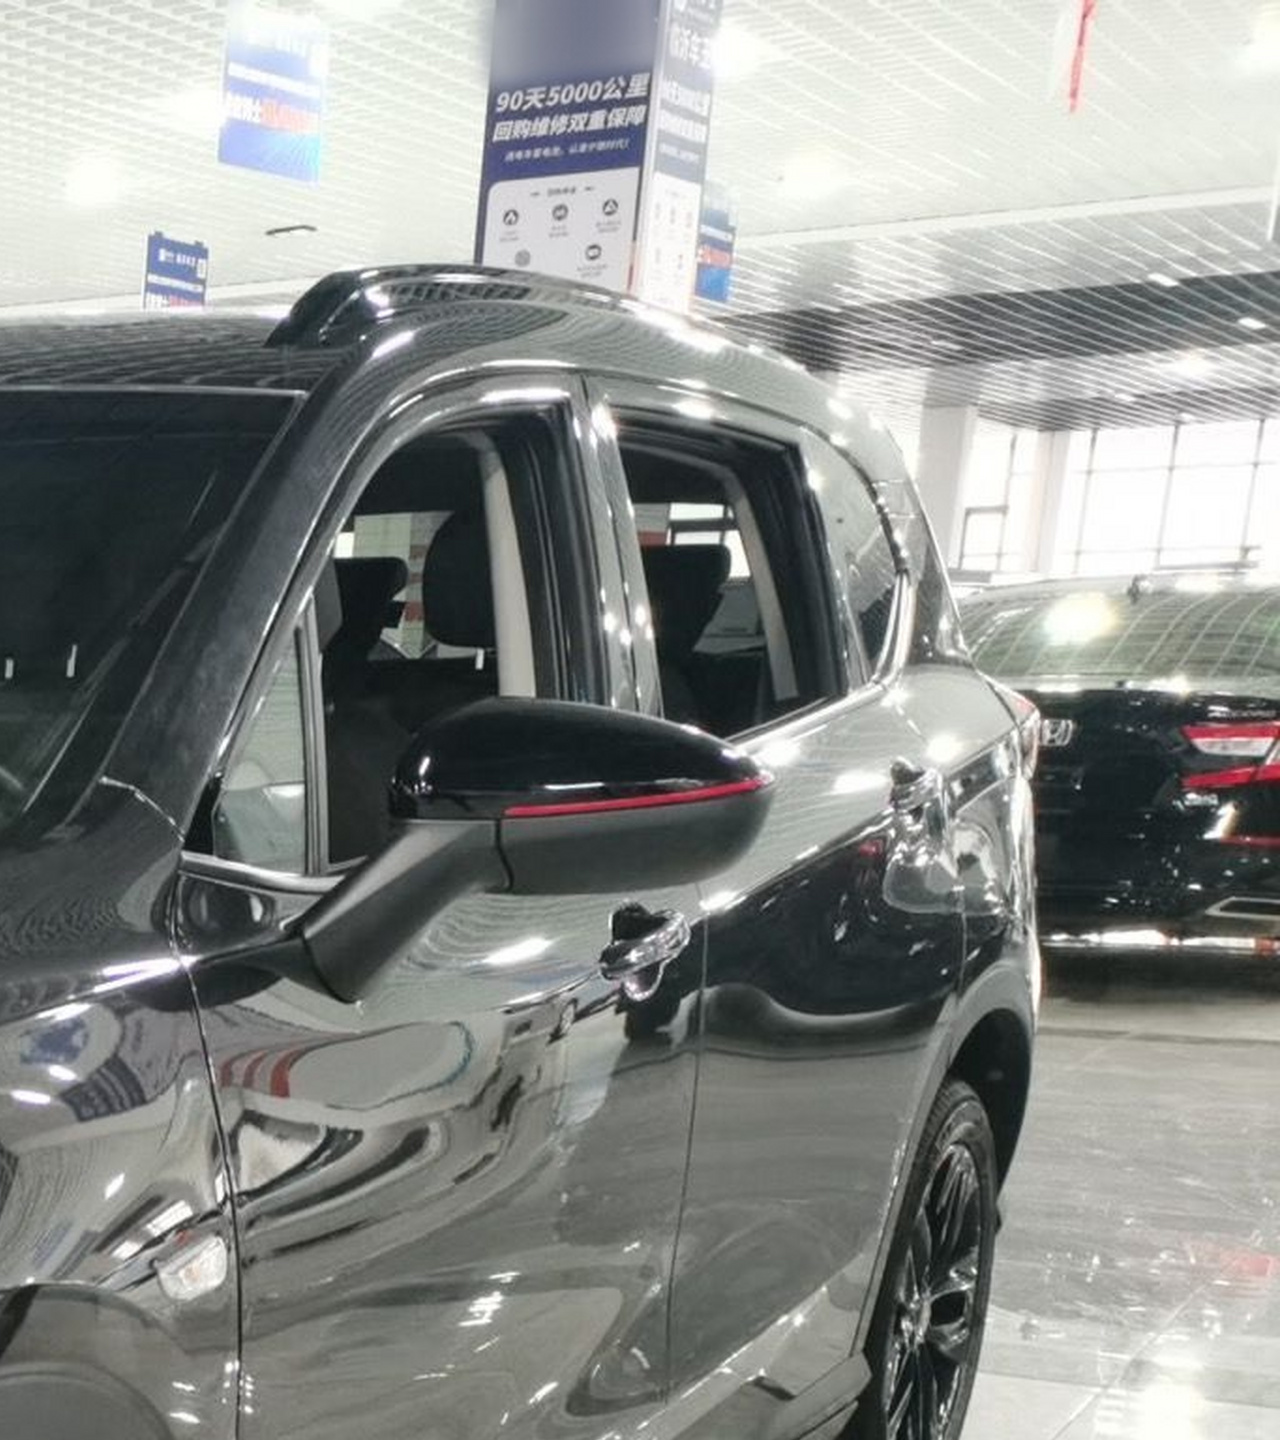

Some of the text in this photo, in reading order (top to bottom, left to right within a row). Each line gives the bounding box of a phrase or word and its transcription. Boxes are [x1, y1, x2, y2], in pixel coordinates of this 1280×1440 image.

[496, 73, 651, 113] 90天5000公里
[492, 105, 647, 143] 回购维修双重保障
